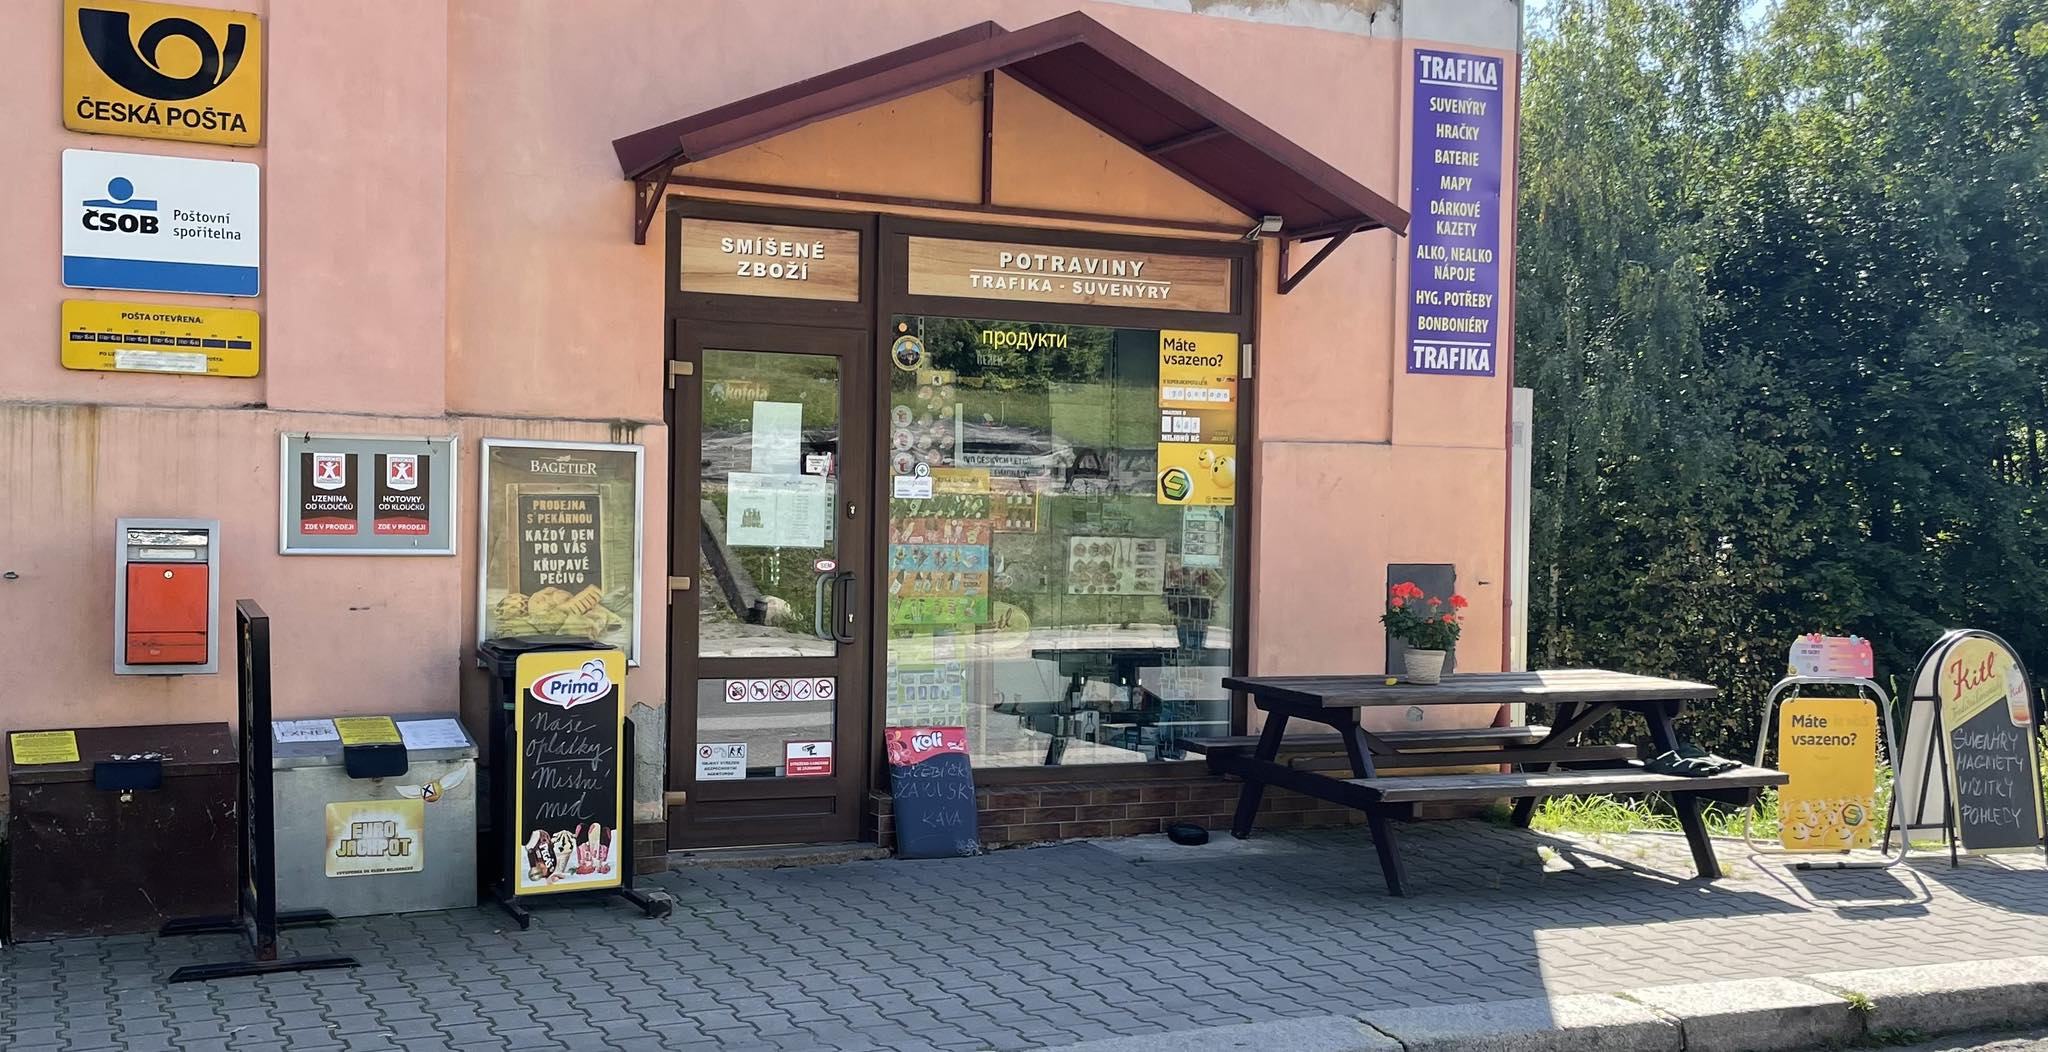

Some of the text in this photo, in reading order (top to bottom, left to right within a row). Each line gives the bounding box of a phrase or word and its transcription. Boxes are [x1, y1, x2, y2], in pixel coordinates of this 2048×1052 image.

[1420, 55, 1498, 85] TRAFIKA
[77, 96, 247, 132] ČESKÁ POŠTA
[1429, 97, 1486, 116] SUVENÝRY
[1436, 123, 1479, 141] HRAČKY
[1435, 149, 1479, 166] BATERIE
[1440, 175, 1472, 192] MAPY
[173, 209, 231, 225] Poštovní
[1430, 199, 1481, 218] DÁRKOVÉ
[82, 209, 159, 234] ČSOB
[1436, 220, 1477, 237] KAZETY
[173, 226, 242, 241] spořitelna
[720, 236, 825, 260] SMÍŠENÉ
[1416, 245, 1493, 264] ALKO, NEALKO
[736, 261, 809, 280] ZBOŽÍ
[1000, 251, 1145, 278] POTRAVINY
[1434, 265, 1476, 282] NÁPOJE
[969, 274, 1053, 293] TRAFIKA
[1072, 280, 1171, 300] SUVENÝRY
[1416, 290, 1493, 308] HYG. POTŘEBY
[121, 312, 151, 321] POŠTA
[1418, 316, 1489, 333] BONBONIÉRY
[982, 330, 1068, 352] продукти
[1163, 338, 1196, 352] Máte
[1163, 354, 1223, 367] vsazeno?
[1413, 346, 1490, 371] TRAFIKA
[530, 459, 597, 475] BAGETIER
[305, 502, 318, 510] OD
[311, 495, 348, 503] UZENINA
[378, 503, 390, 511] OD
[533, 500, 586, 511] PRODEJNA
[527, 511, 593, 525] S PEKÁRNOU
[525, 526, 595, 542] KAŽDÝ DEN
[534, 540, 587, 555] PRO VÁS
[533, 556, 589, 572] KŘUPAVÉ
[539, 570, 584, 585] PEČIVO
[1950, 651, 1996, 702] Kitl
[550, 679, 599, 696] Prima
[1791, 714, 1828, 728] Máte
[1791, 733, 1857, 746] vsazeno?
[351, 821, 396, 839] EURO
[336, 838, 412, 857] JACKPOT
